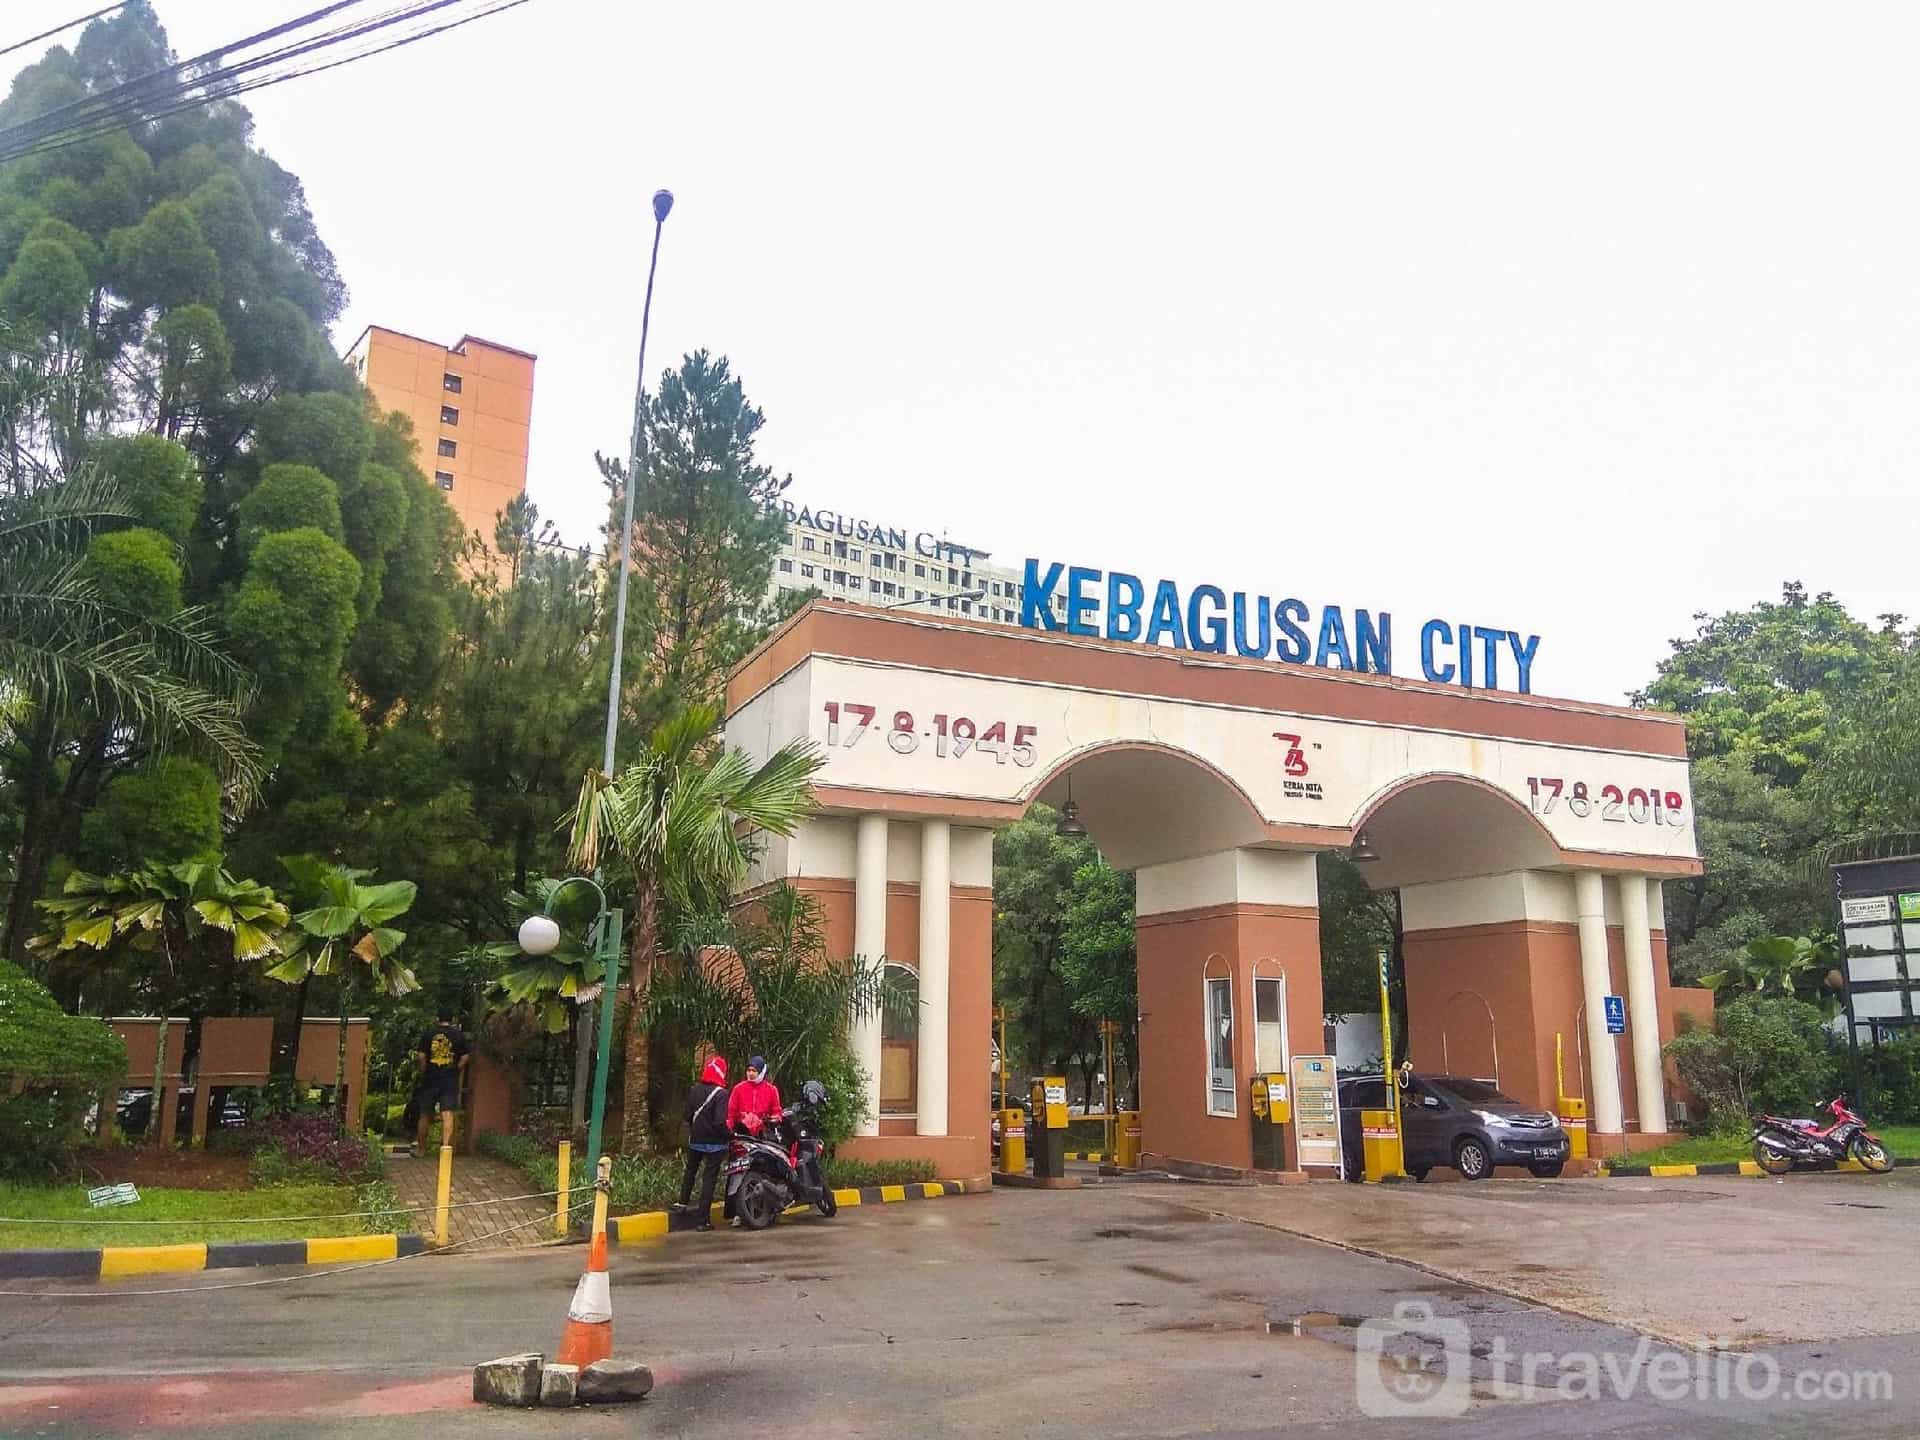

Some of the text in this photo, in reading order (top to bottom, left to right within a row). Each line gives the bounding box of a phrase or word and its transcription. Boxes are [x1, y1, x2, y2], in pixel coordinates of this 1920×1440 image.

[766, 499, 907, 551] BAGUSAN
[1021, 558, 1541, 694] KEBAGUSAN CITY
[1305, 783, 1323, 793] KITA
